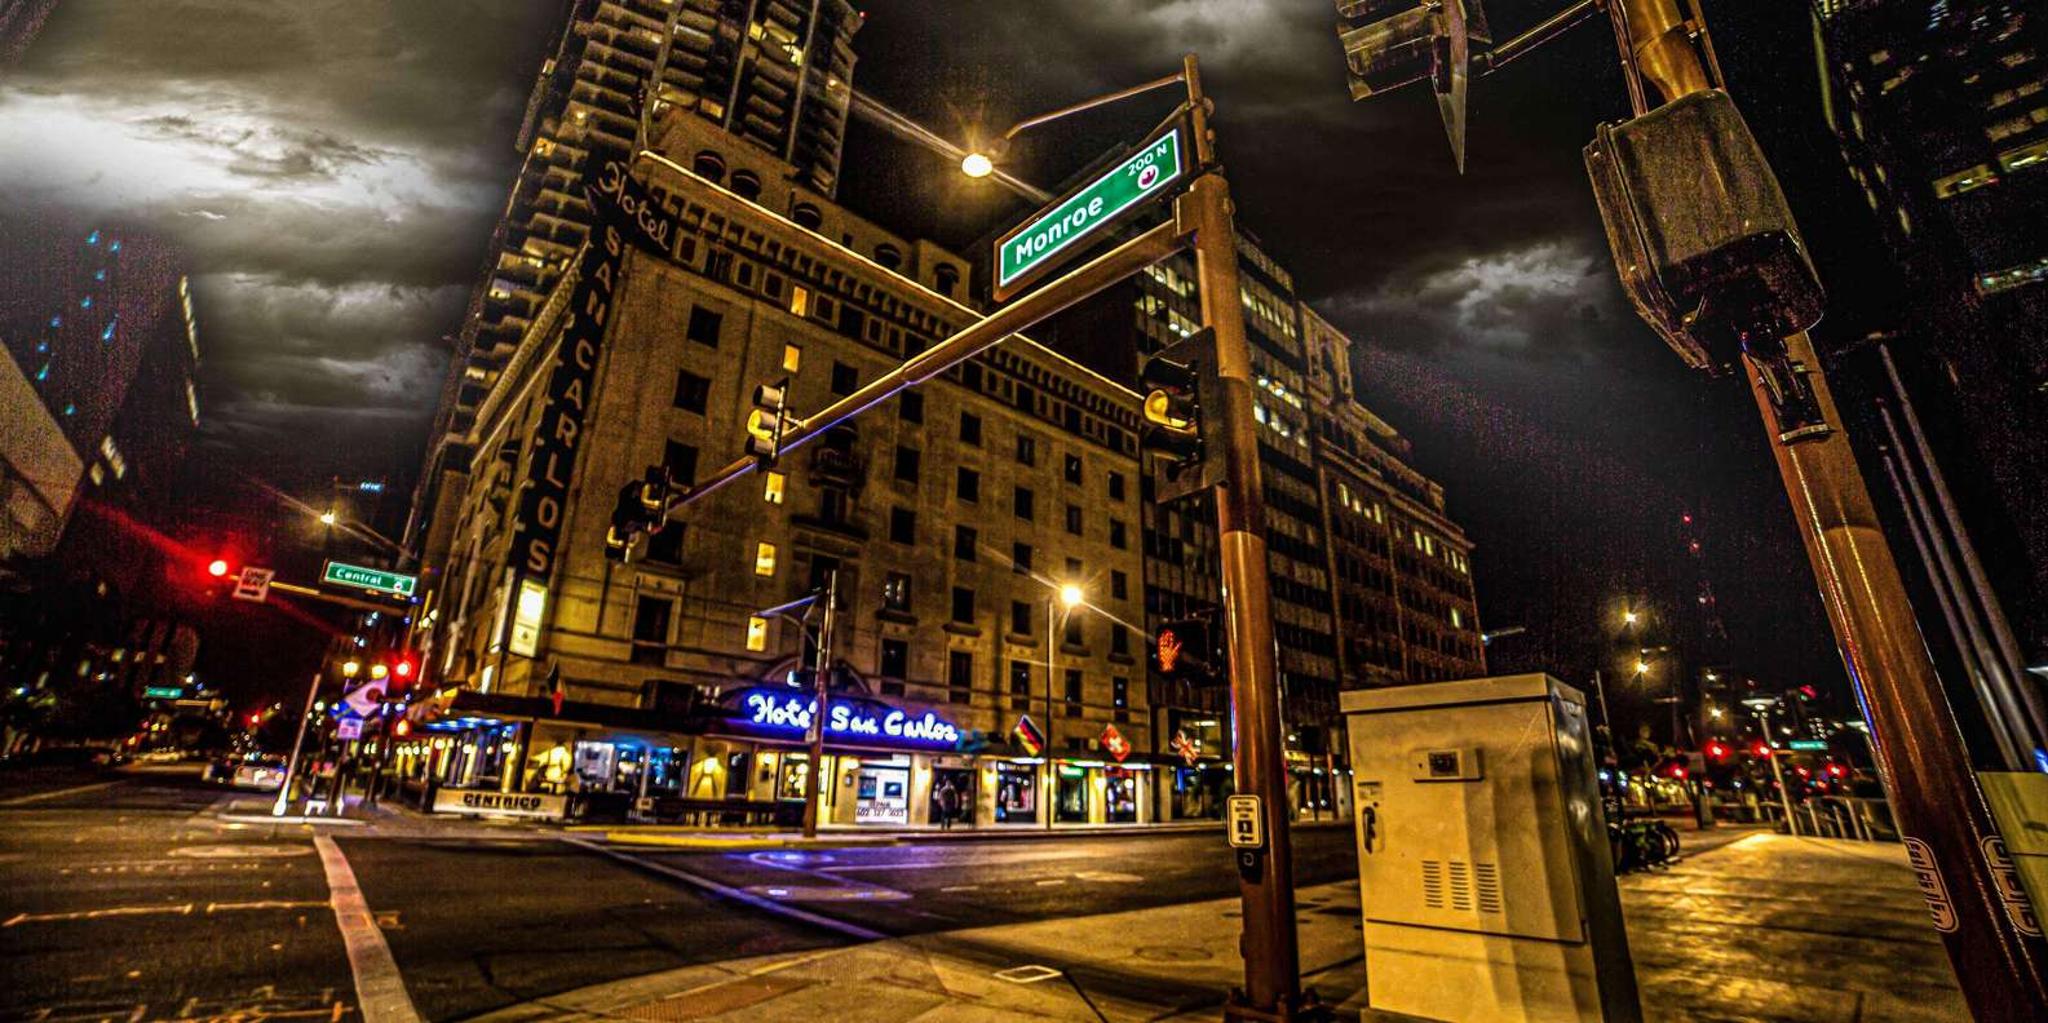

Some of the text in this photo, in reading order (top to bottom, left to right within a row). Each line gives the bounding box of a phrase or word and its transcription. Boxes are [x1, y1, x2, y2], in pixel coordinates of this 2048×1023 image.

[1128, 144, 1167, 176] 200 N
[598, 161, 670, 251] Hotel
[1015, 195, 1104, 265] Monroe
[527, 226, 621, 573] SAN CARLOS
[335, 568, 382, 585] Central
[831, 706, 878, 734] San
[884, 711, 958, 742] Carlos
[463, 793, 541, 811] CENTRICO
